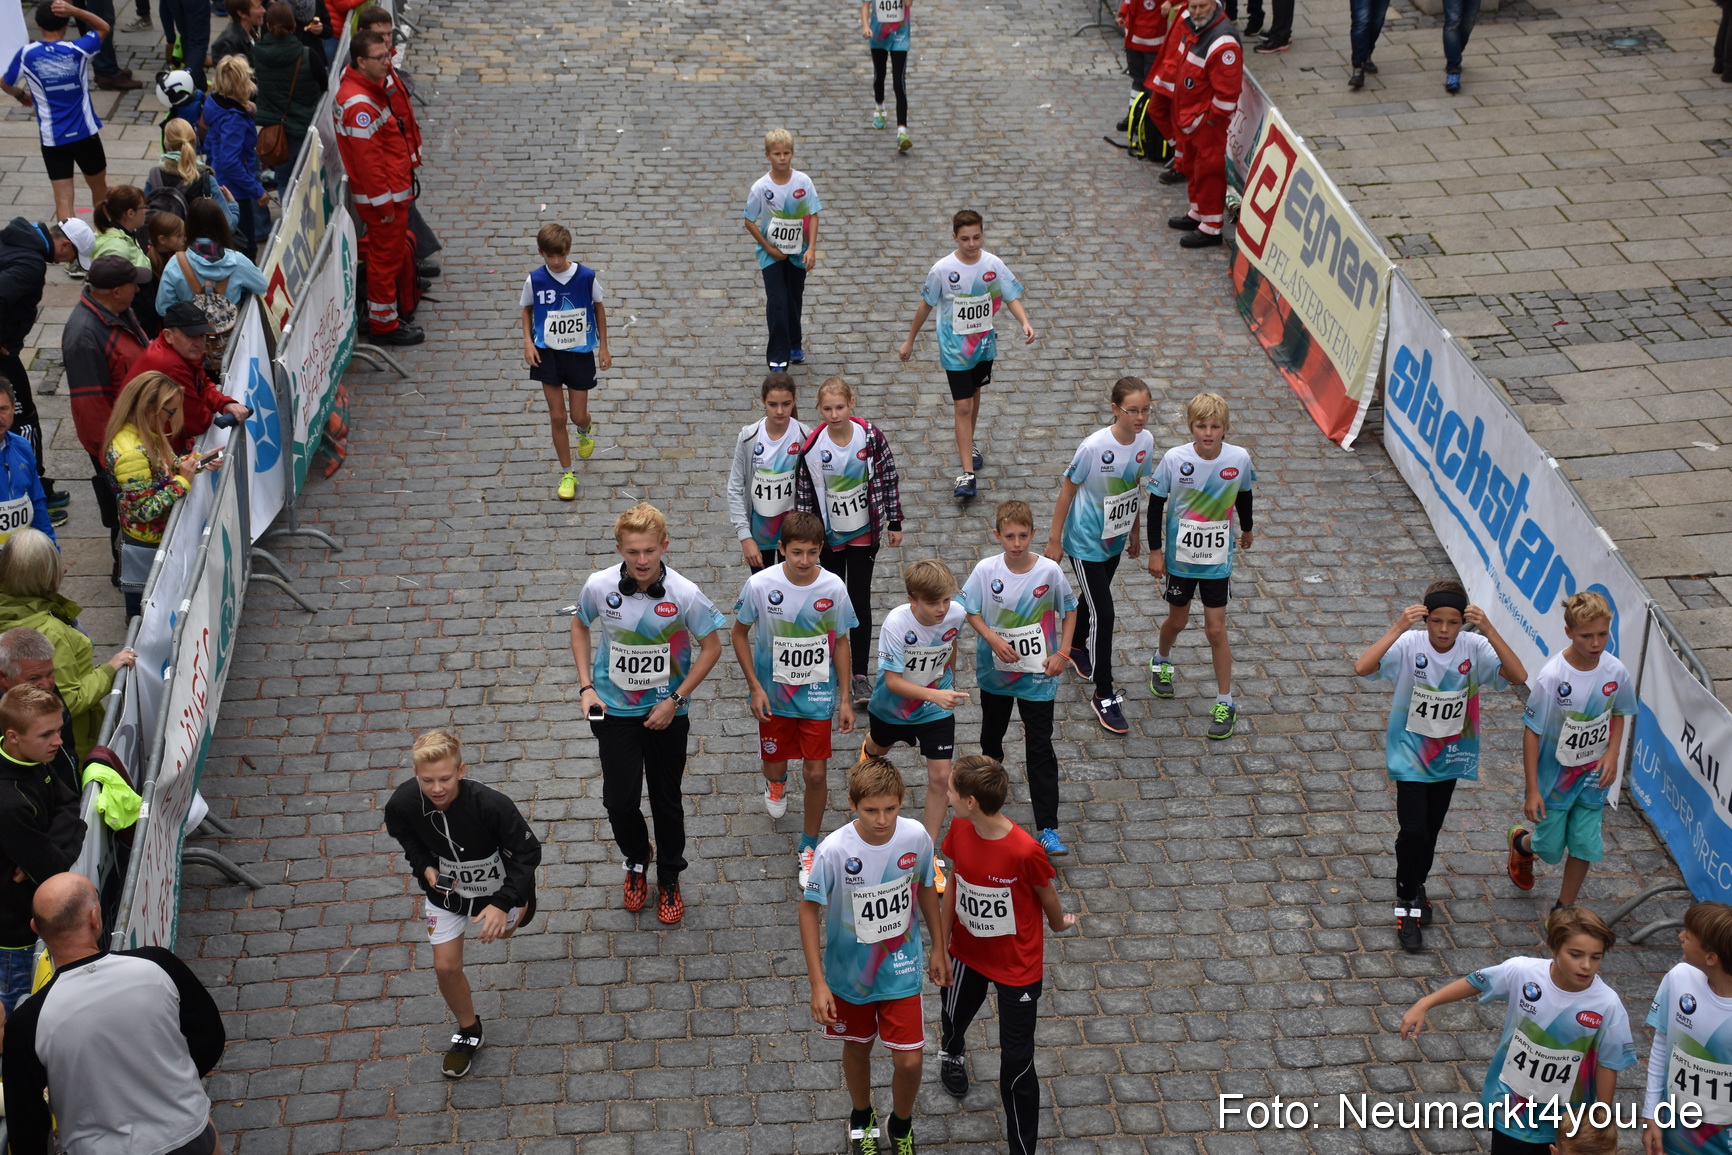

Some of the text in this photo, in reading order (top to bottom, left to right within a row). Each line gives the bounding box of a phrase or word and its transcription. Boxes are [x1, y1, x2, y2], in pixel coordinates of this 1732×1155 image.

[879, 1, 903, 11] 4044
[771, 227, 802, 241] 4007
[536, 289, 556, 305] 13
[958, 303, 990, 320] 4008
[1265, 241, 1360, 380] PFLASTERSTEINE
[549, 318, 583, 335] 4025
[754, 482, 793, 500] 4114
[840, 489, 861, 500] Neumarkt
[832, 493, 868, 516] 4115
[1109, 497, 1138, 521] 4016
[1182, 531, 1225, 549] 4015
[606, 609, 622, 617] PARTL
[1008, 630, 1035, 638] Neumarkt
[611, 646, 631, 655] PARTL
[1008, 636, 1041, 656] 105
[615, 655, 664, 674] 4020
[779, 647, 825, 667] 4003
[905, 652, 947, 671] 4112
[628, 677, 650, 685] David
[790, 670, 812, 679] David
[1413, 691, 1461, 702] PARTL Neumarkt
[1415, 700, 1464, 720] 4102
[1564, 721, 1584, 731] PARTL
[1565, 724, 1607, 750] 4032
[1447, 744, 1459, 753] 16.
[1575, 749, 1594, 760] Kilian
[1681, 717, 1732, 816] RAIL.
[1634, 738, 1661, 779] AUF
[1661, 770, 1694, 835] JEDER
[440, 860, 492, 870] PARTL Neumarkt
[463, 885, 488, 893] Philip
[853, 881, 906, 899] PARTL Neumarkt
[969, 889, 999, 898] Neumarkt
[861, 888, 910, 921] 4045
[960, 892, 1008, 918] 4026
[877, 920, 902, 934] Jonas
[969, 920, 995, 931] Niklas
[892, 949, 908, 961] 16.
[1519, 999, 1537, 1013] PARTL
[1580, 1013, 1602, 1026] Hervis
[1676, 1012, 1694, 1027] PARTL
[1514, 1035, 1570, 1062] PARTL Neumarkt
[1513, 1050, 1572, 1084] 4104
[1673, 1051, 1732, 1078] PARTL Neumarkt
[1674, 1067, 1732, 1102] 4111
